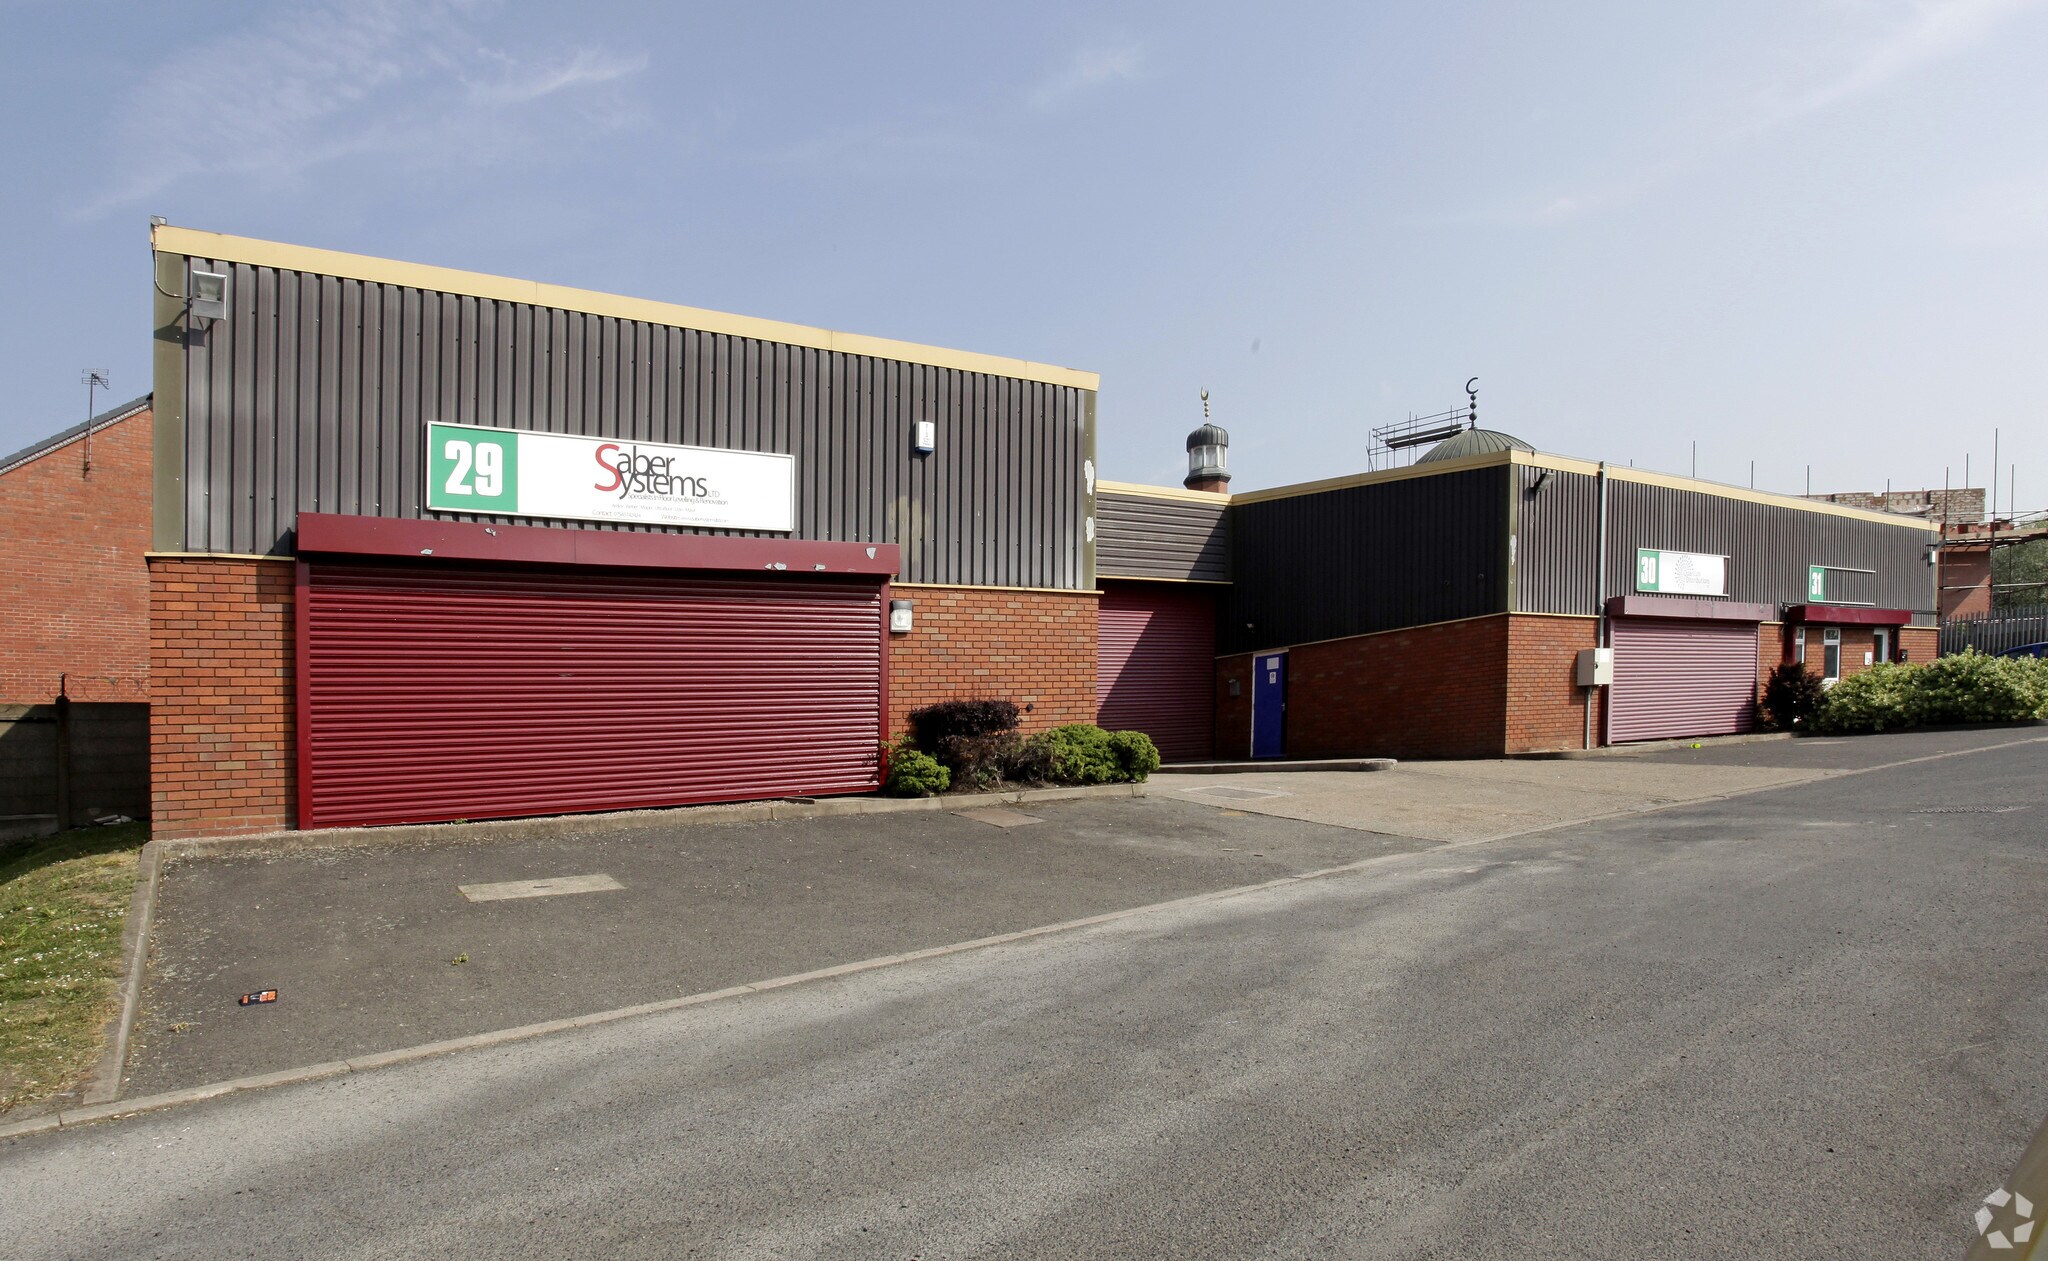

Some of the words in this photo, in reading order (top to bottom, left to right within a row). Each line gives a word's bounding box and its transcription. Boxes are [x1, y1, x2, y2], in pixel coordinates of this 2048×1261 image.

[444, 440, 504, 497] 29
[594, 443, 676, 484] Saber
[628, 492, 653, 501] Specialists
[658, 494, 673, 502] Floor
[700, 498, 729, 506] Renovation
[1641, 556, 1656, 584] 30
[1812, 572, 1822, 595] 31
